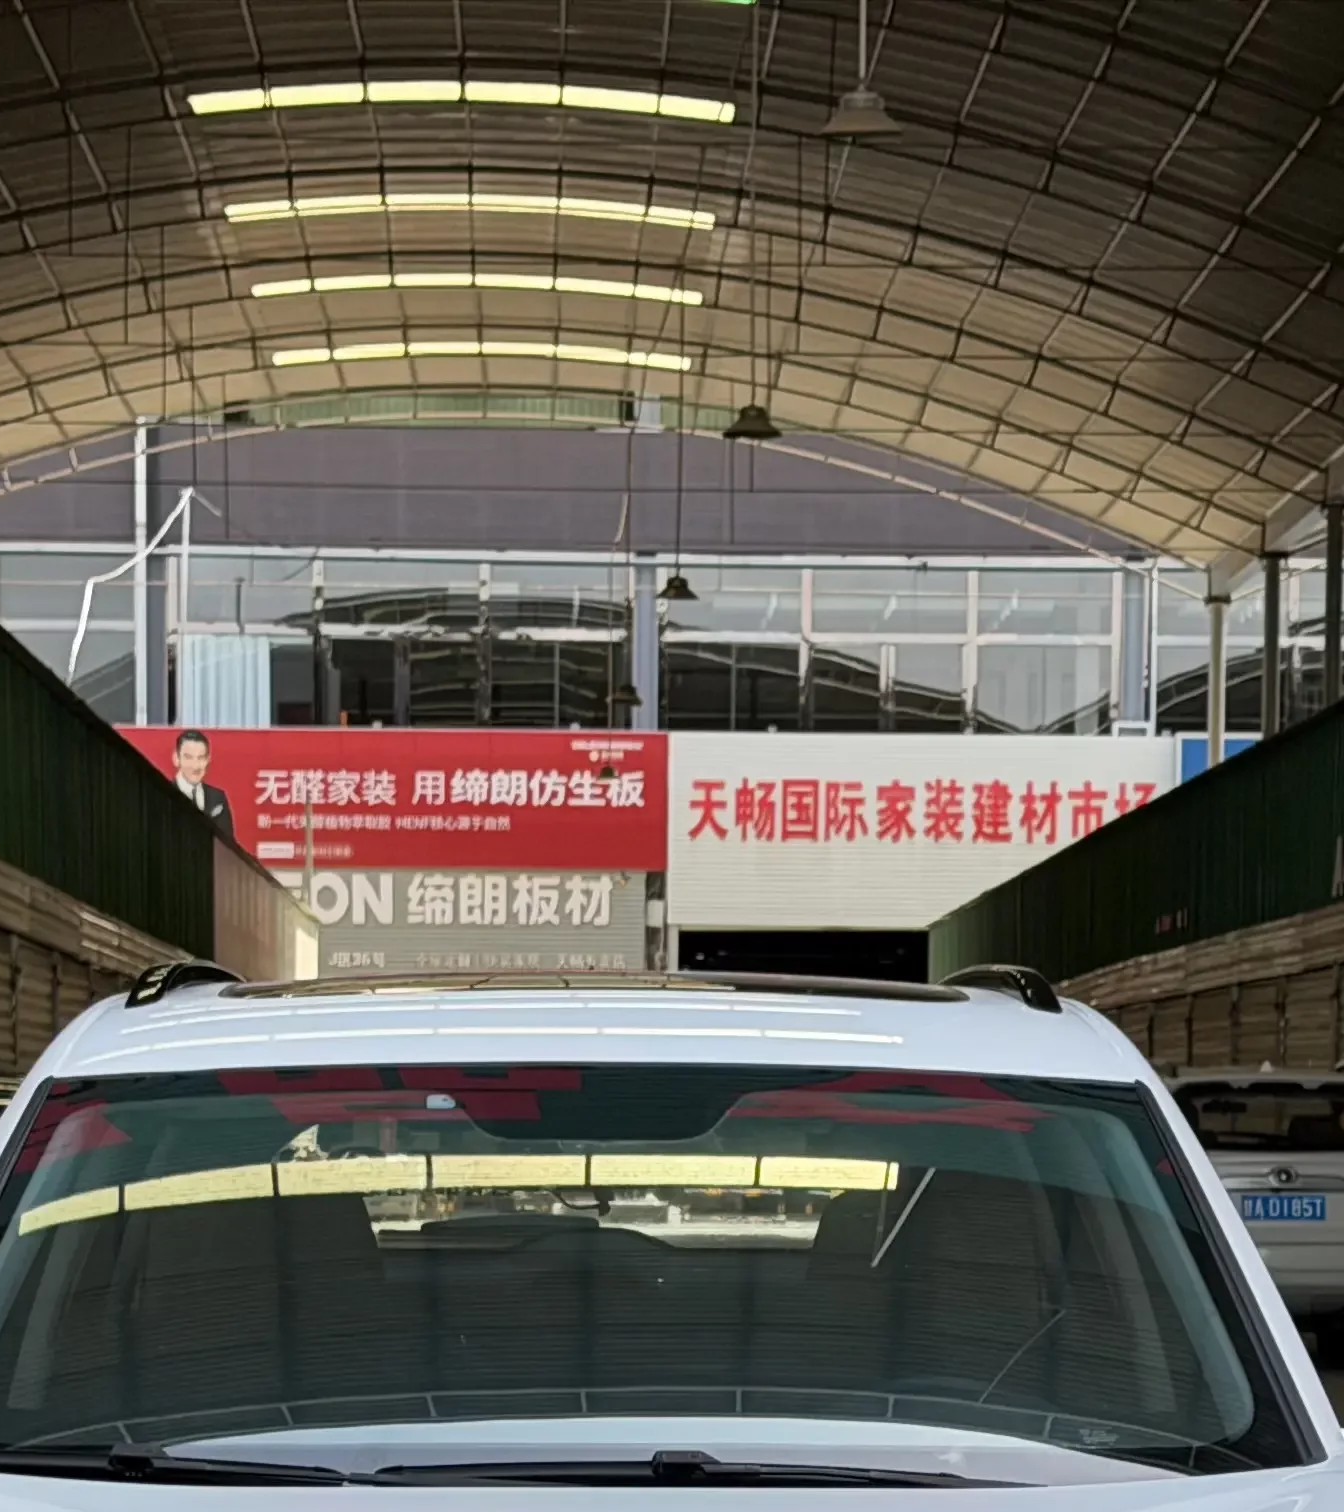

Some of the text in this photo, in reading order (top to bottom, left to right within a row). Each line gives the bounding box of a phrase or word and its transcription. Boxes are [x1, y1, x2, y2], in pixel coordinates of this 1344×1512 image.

[254, 768, 397, 806] 无醛家装
[406, 871, 614, 927] 缔朗板材
